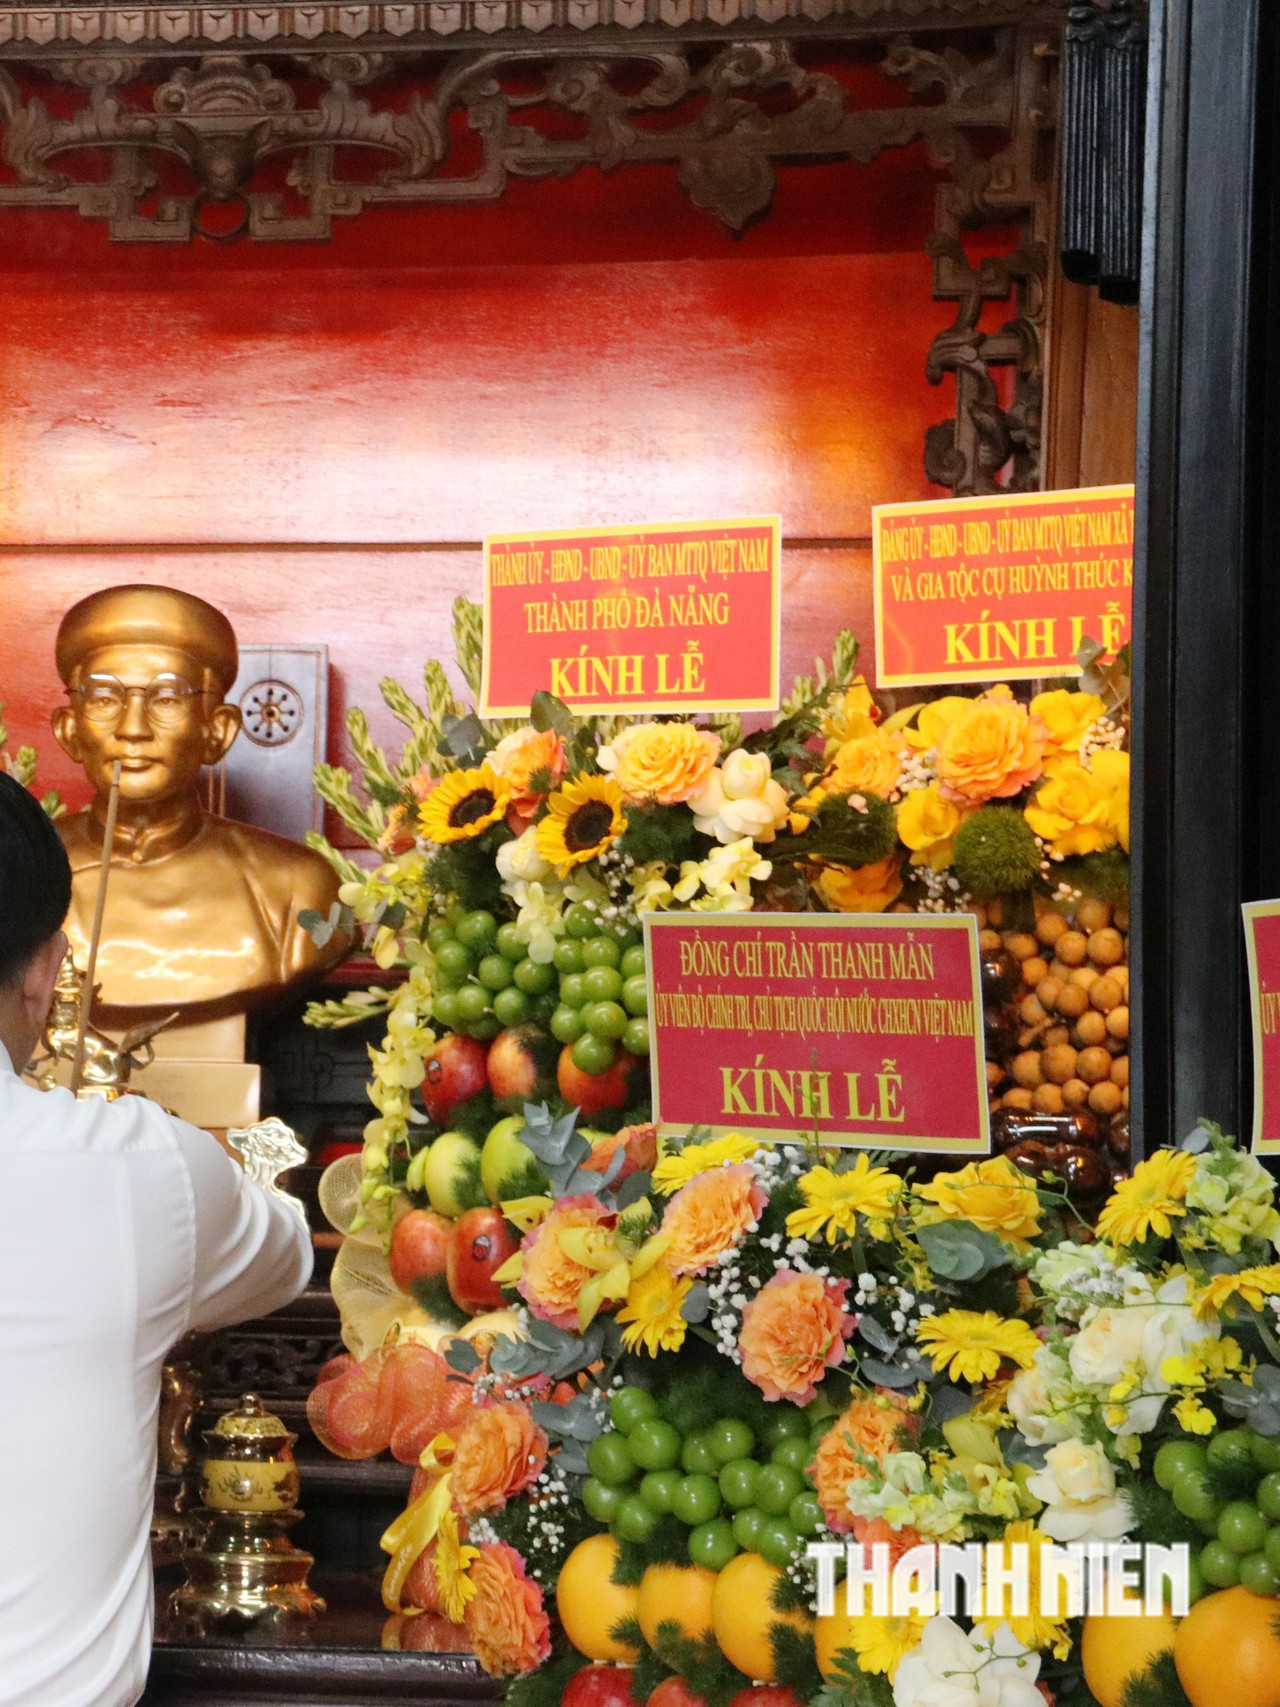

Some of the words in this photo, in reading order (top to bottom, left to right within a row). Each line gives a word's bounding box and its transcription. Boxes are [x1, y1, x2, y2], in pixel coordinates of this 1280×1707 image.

[491, 543, 527, 586] THÀNH
[550, 549, 583, 583] HĐND
[590, 546, 621, 581] UBND
[647, 543, 673, 577] BAN
[674, 541, 708, 583] MTTQ
[710, 533, 737, 581] VIỆT
[738, 537, 769, 573] NAM
[881, 519, 908, 562] ĐẢNG
[929, 524, 957, 558] HĐND
[963, 521, 991, 556] UBND
[1012, 518, 1033, 552] BAN
[1034, 514, 1063, 557] MTTQ
[1063, 507, 1087, 555] VIỆT
[1087, 511, 1112, 546] NAM
[891, 566, 915, 602] VÀ
[917, 572, 946, 601] GIA
[946, 562, 980, 603] TỘC
[982, 566, 1005, 601] CỤ
[1008, 555, 1070, 594] HUỲNH
[1072, 551, 1120, 590] THÚC
[524, 592, 588, 633] THÀNH
[591, 587, 631, 630] PHỐ
[635, 587, 665, 628] ĐÀ
[943, 609, 1057, 664] KÍNH
[549, 645, 645, 697] KÍNH
[654, 640, 705, 694] LỄ
[679, 929, 730, 977] ĐỒNG
[733, 930, 763, 977] CHÍ
[765, 930, 815, 979] TRẦN
[818, 942, 886, 979] THANH
[888, 931, 935, 980] MẪN
[670, 983, 692, 1028] VIÊN
[692, 984, 705, 1036] BỘ
[706, 984, 735, 1029] CHÍNH
[754, 984, 773, 1031] CHỦ
[774, 995, 797, 1038] TỊCH
[797, 986, 826, 1040] QUỐC
[827, 987, 846, 1040] HỘI
[846, 988, 877, 1034] NƯỚC
[877, 998, 921, 1035] CHXHCN
[922, 992, 947, 1044] VIỆT
[947, 1000, 975, 1036] NAM
[720, 1054, 834, 1119] KÍNH
[843, 1058, 906, 1123] LỄ
